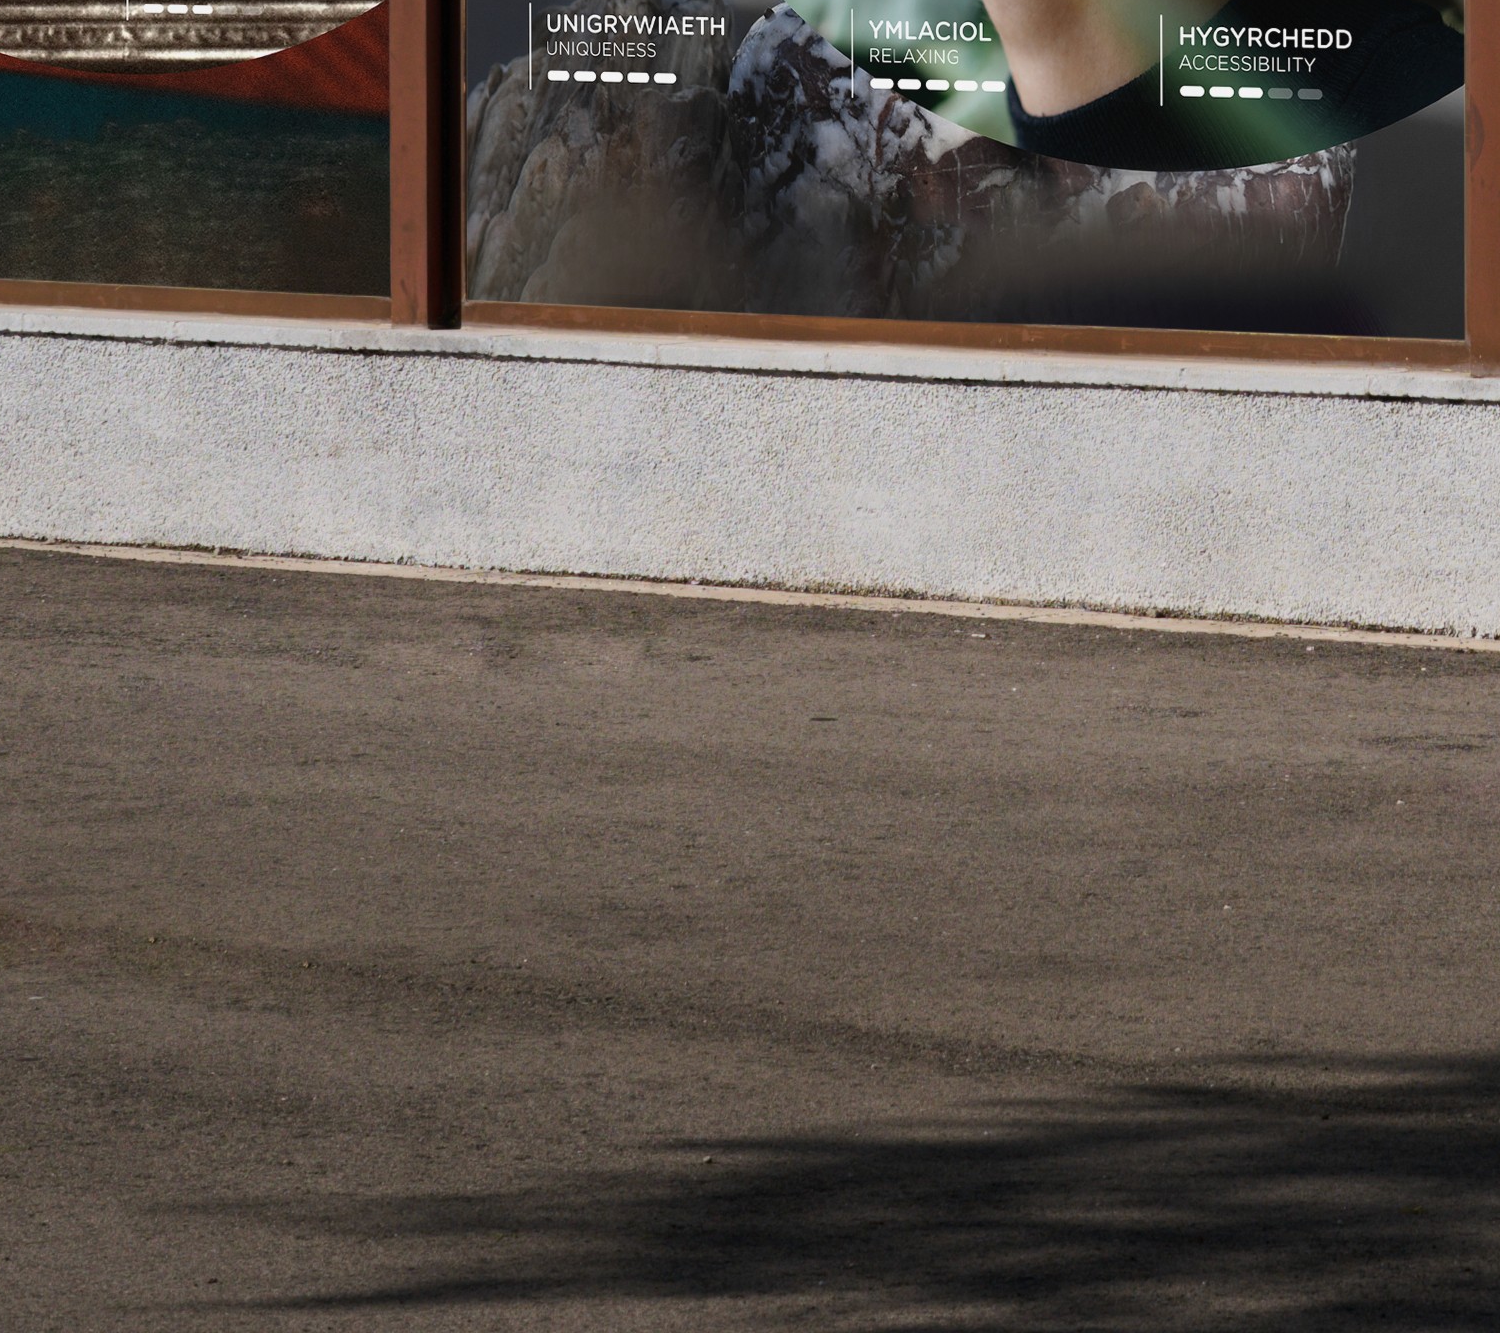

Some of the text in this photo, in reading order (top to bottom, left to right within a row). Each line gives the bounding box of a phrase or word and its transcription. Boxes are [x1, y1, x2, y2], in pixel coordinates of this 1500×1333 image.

[546, 13, 726, 37] UNIGRYWIAETH
[868, 19, 992, 43] YMLACIOL
[1178, 25, 1353, 50] HYGYRCHEDD
[546, 40, 657, 58] UNIQUENESS
[869, 46, 959, 65] RELAXING
[1178, 53, 1316, 74] ACCESSIBILITY
